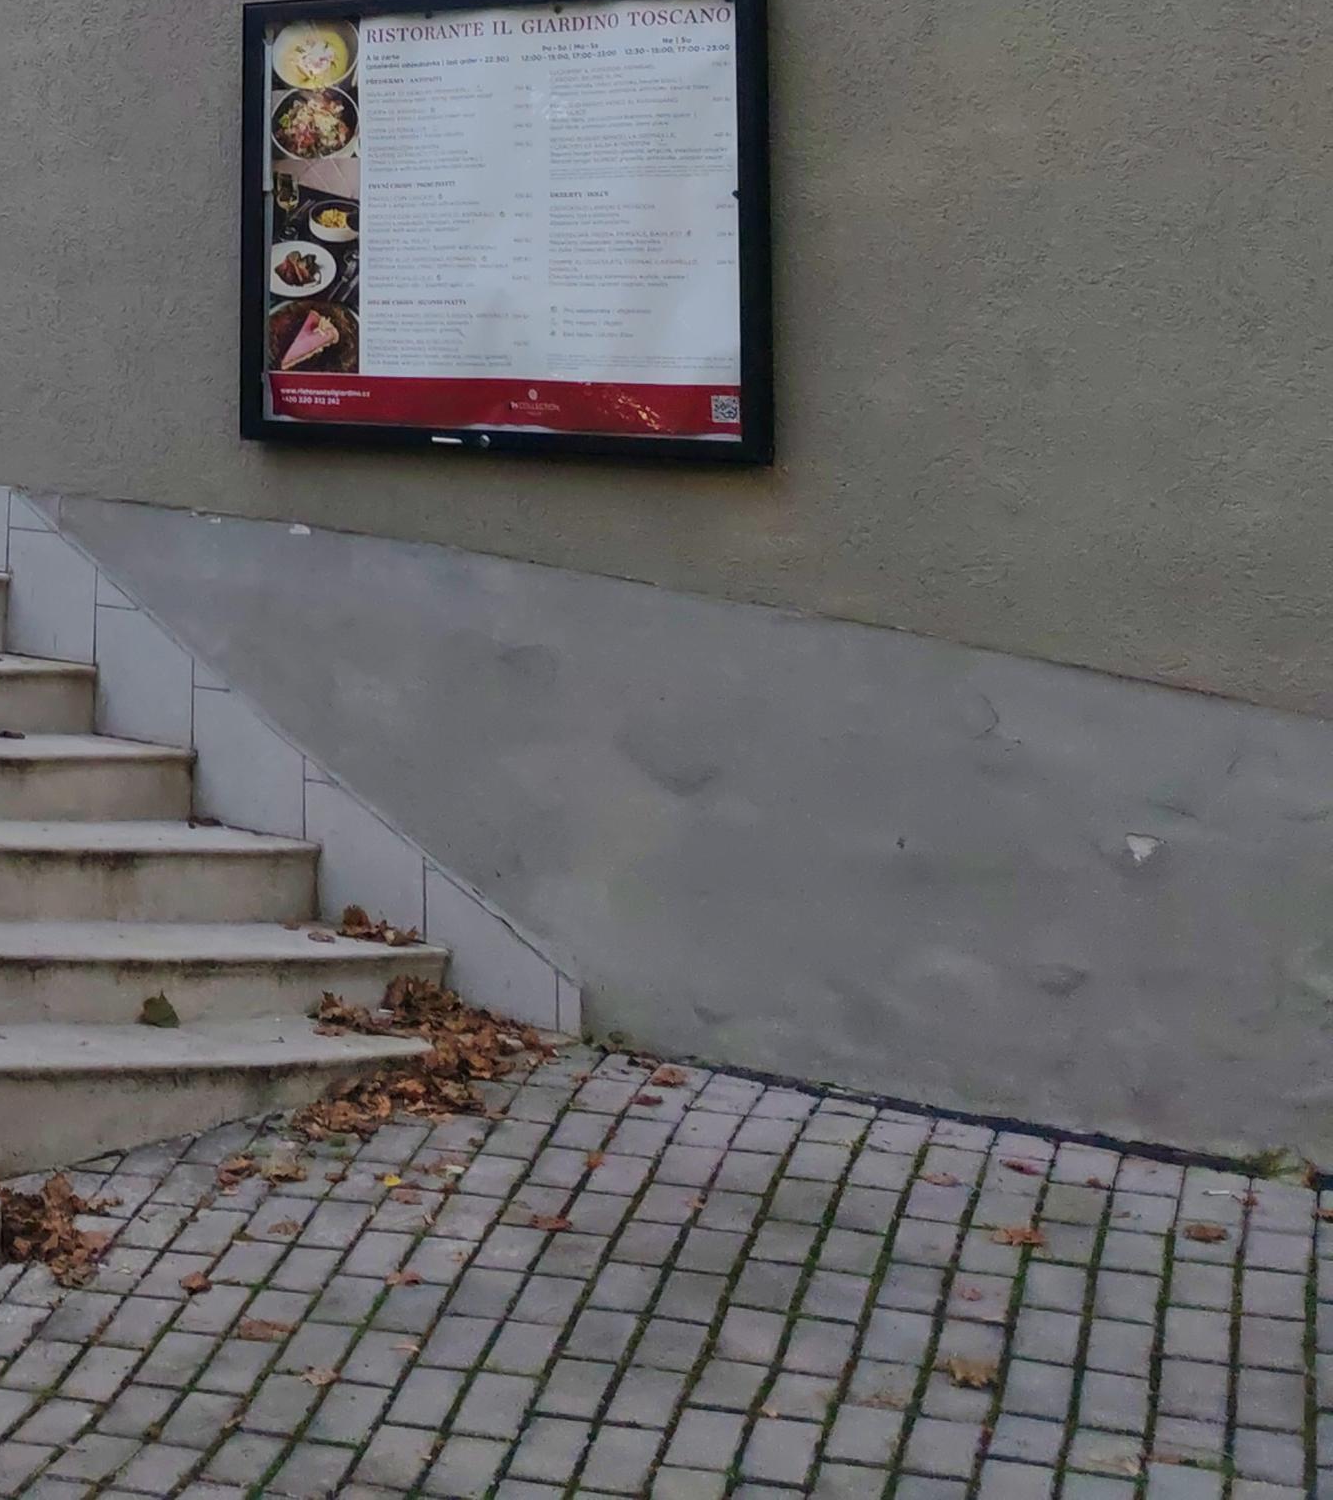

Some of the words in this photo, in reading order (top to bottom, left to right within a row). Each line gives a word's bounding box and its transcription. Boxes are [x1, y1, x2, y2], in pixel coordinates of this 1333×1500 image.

[365, 21, 484, 44] RISTORANTE
[492, 19, 513, 36] IL
[521, 13, 620, 35] GIARDINO
[627, 6, 732, 27] TOSCANO
